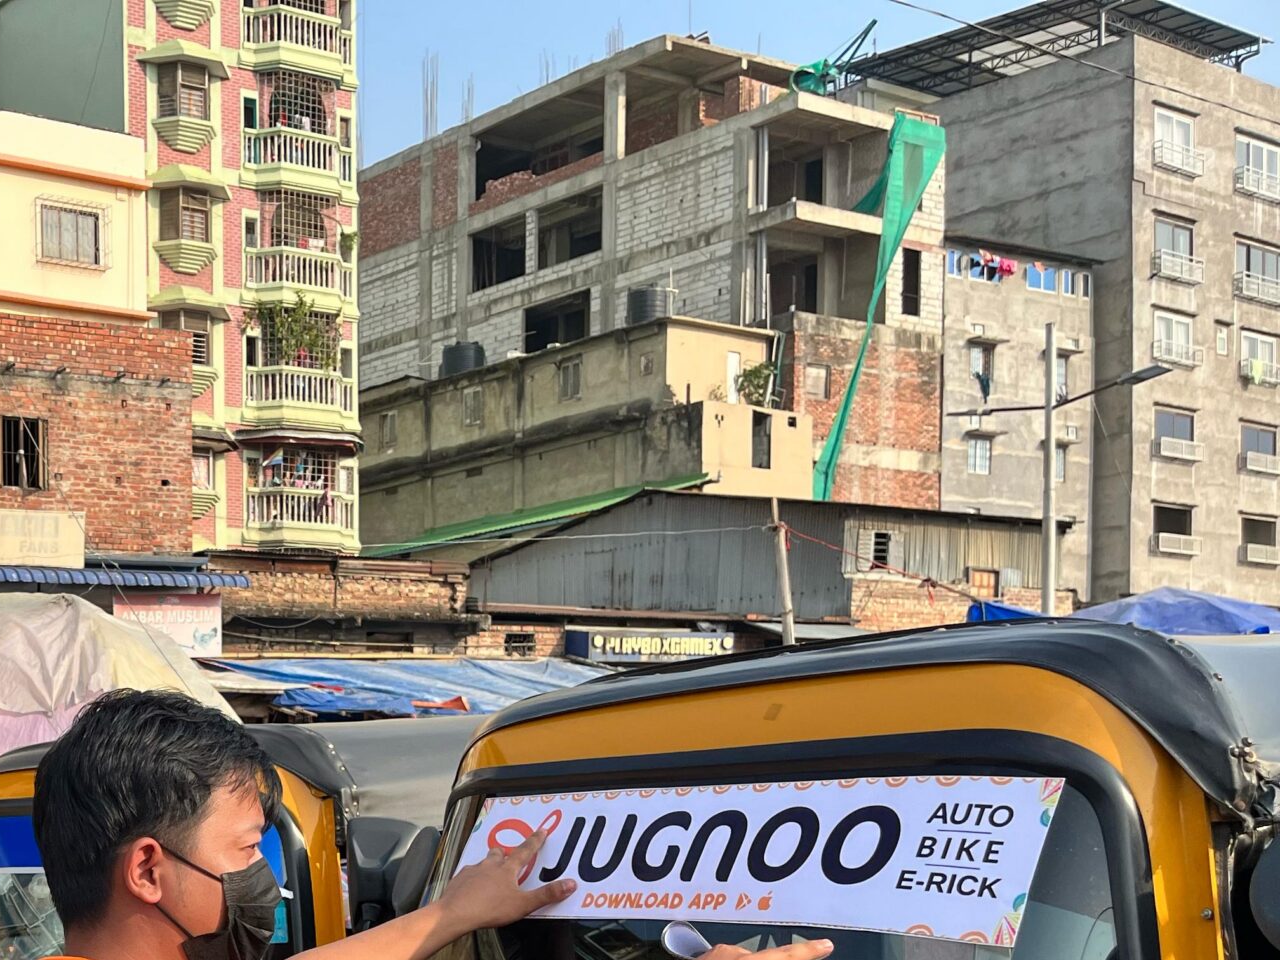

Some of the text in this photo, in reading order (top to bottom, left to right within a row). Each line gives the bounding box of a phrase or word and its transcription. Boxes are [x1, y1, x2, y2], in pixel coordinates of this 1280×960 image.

[19, 540, 59, 553] FANS
[122, 609, 215, 625] AKBAR MUSLIM
[926, 803, 1015, 829] AUTO
[539, 804, 901, 886] JUGNOO
[915, 835, 1005, 865] BIKE
[895, 869, 1004, 900] E-RICK
[581, 890, 727, 912] DOWNLOAD APP
